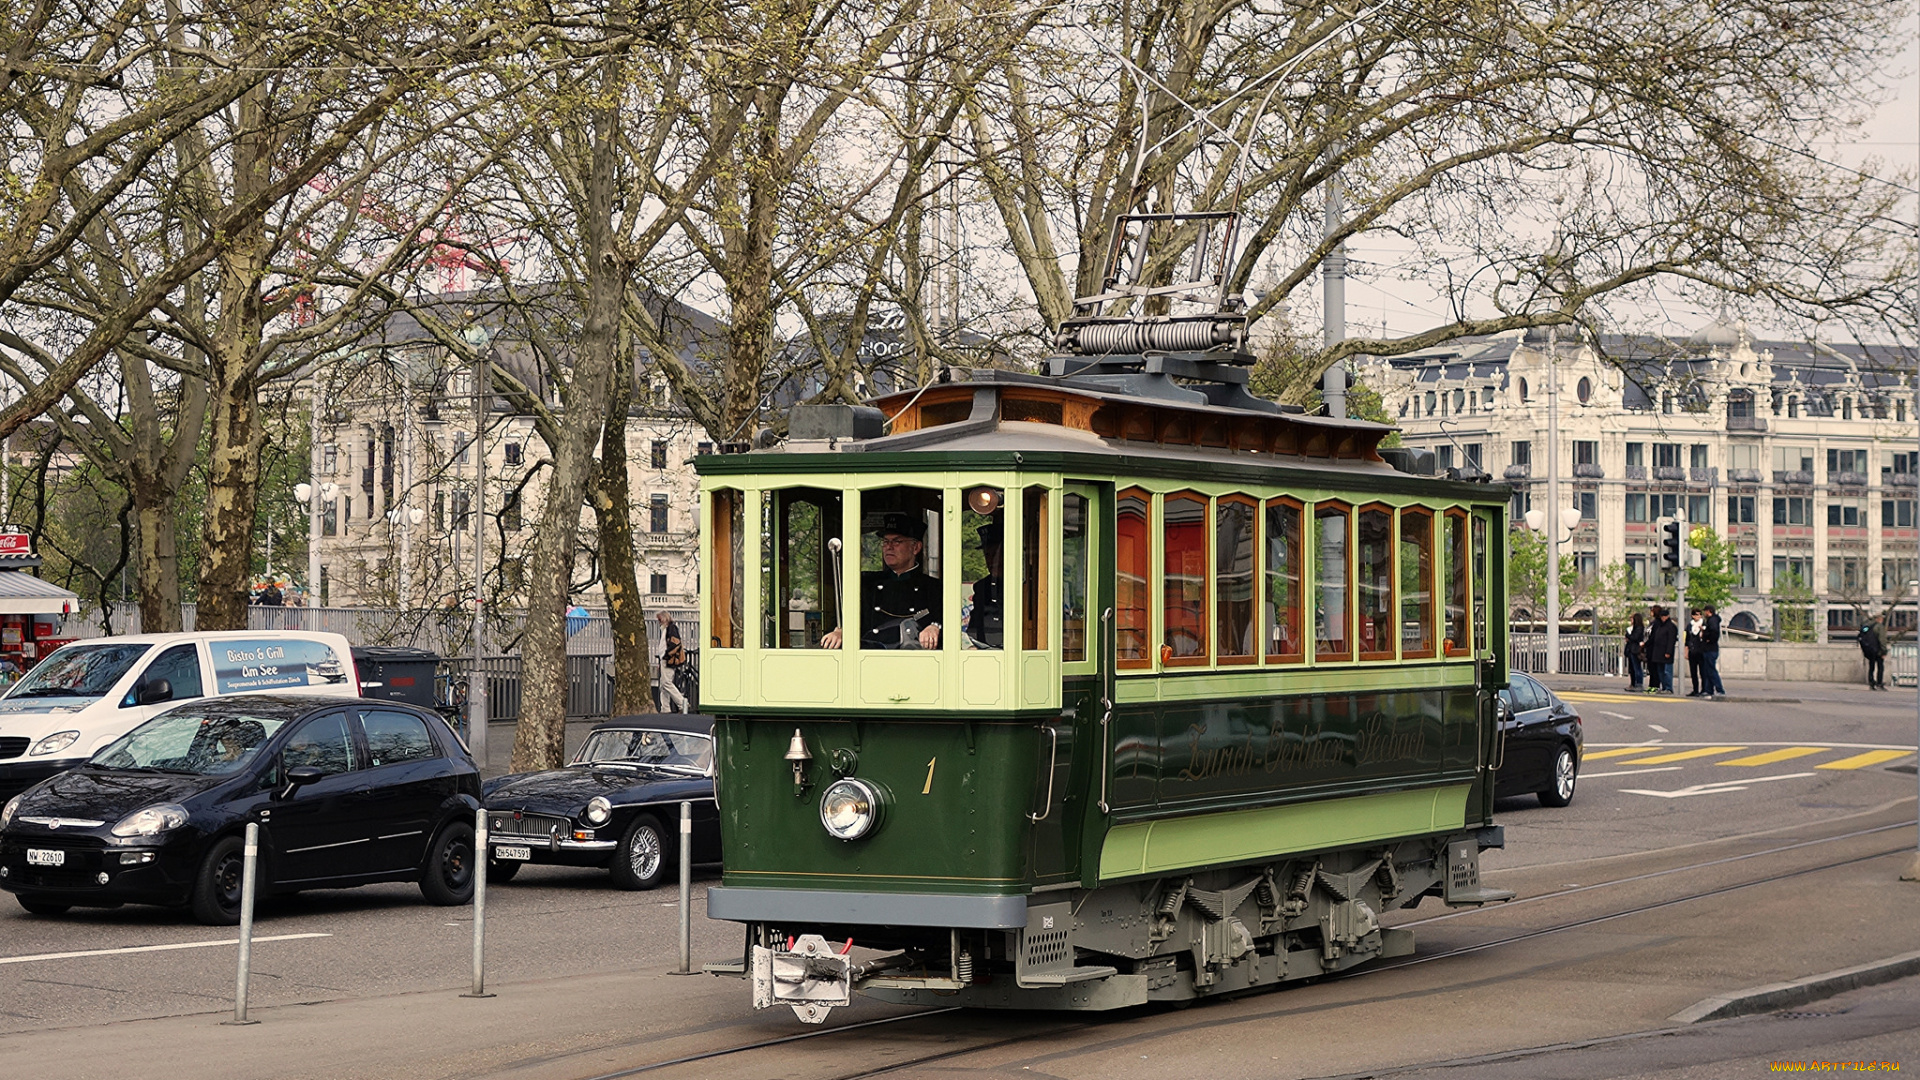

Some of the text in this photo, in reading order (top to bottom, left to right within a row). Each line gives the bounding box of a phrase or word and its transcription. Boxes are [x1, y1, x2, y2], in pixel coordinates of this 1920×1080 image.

[227, 646, 285, 662] Bistro & Grill
[242, 664, 278, 678] Am See
[921, 756, 936, 794] 1
